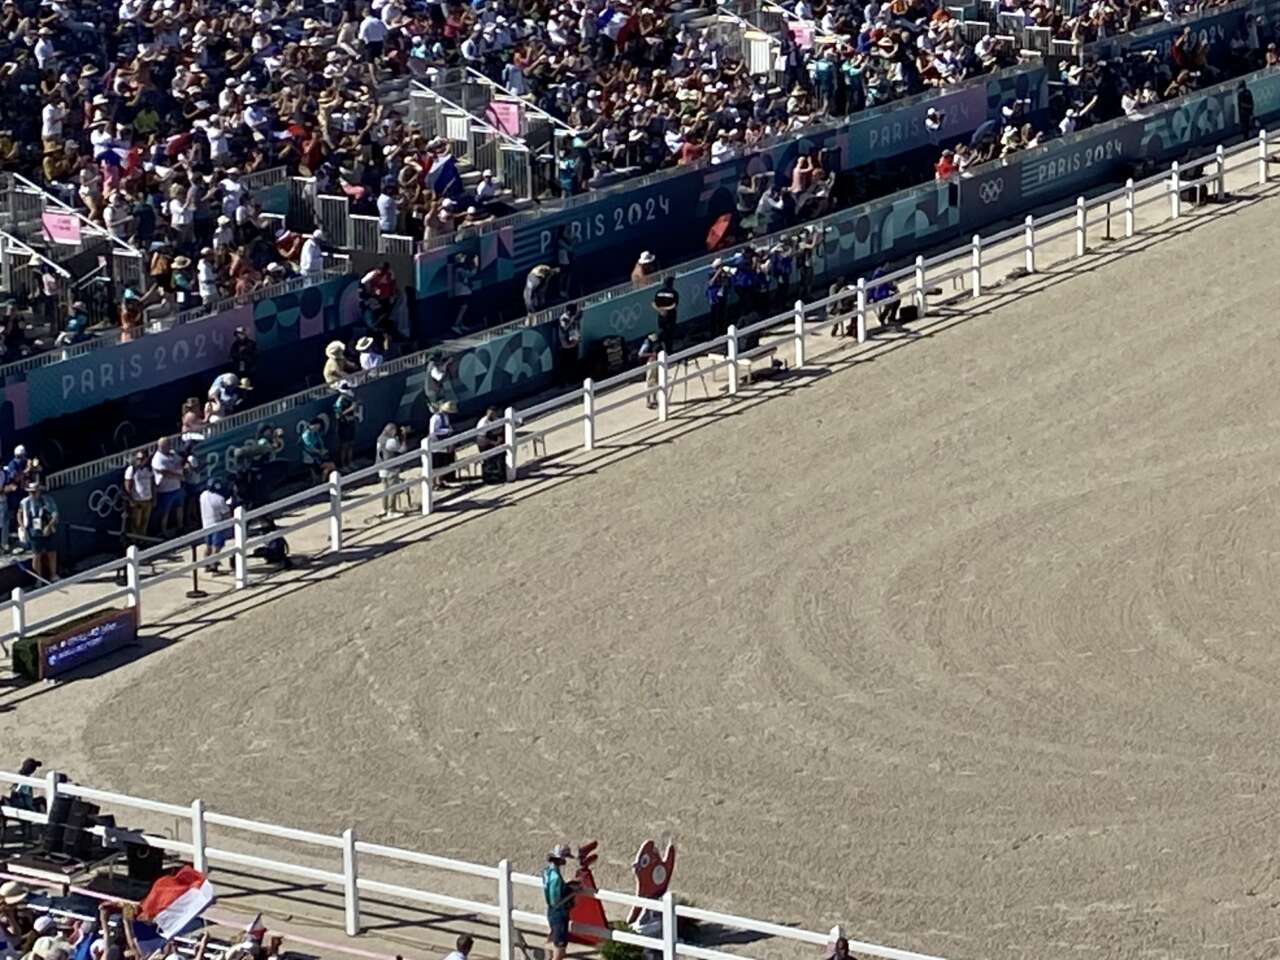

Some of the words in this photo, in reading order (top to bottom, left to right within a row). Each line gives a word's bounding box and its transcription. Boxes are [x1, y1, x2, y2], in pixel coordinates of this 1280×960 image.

[870, 119, 920, 149] PARIS
[1039, 152, 1080, 183] PARIS
[1085, 139, 1122, 167] 2024
[540, 214, 605, 254] PRIS
[614, 194, 670, 231] 2024
[62, 354, 142, 400] PARIS
[154, 329, 225, 371] 2024
